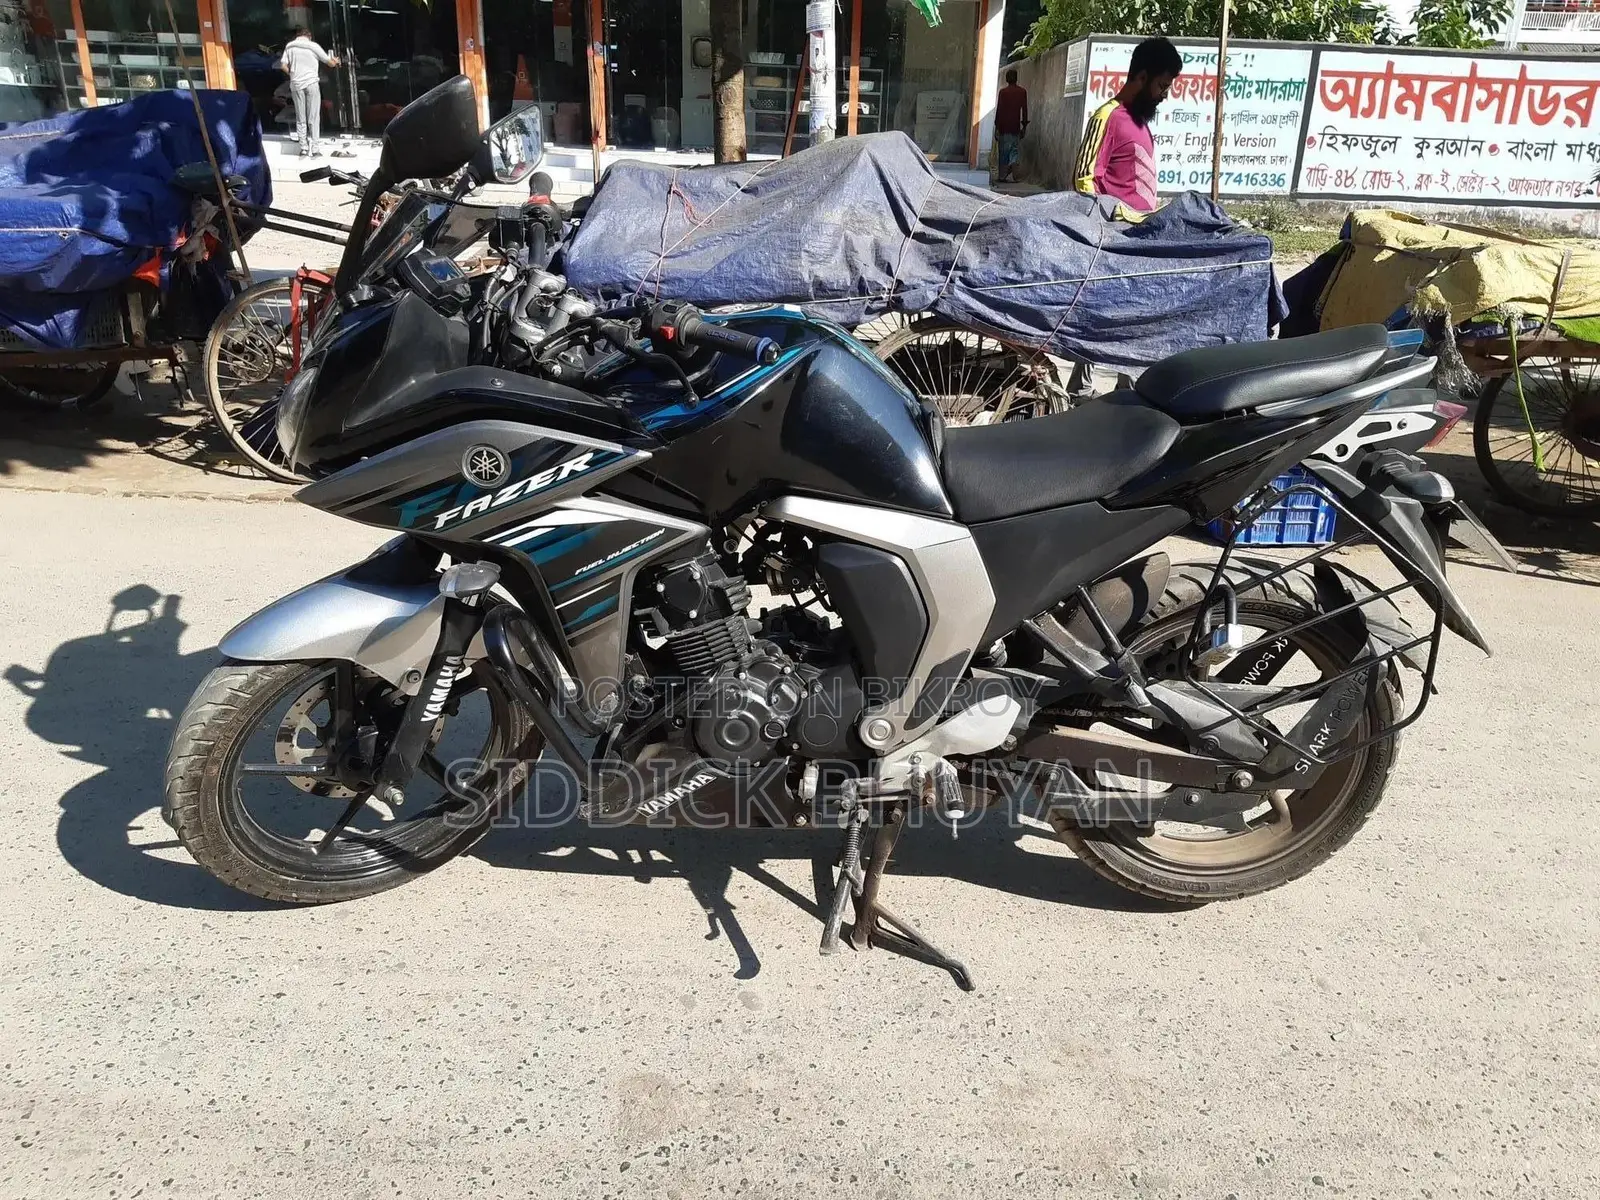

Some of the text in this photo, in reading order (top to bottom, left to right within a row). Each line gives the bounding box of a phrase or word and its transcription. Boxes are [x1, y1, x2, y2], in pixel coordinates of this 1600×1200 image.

[1168, 67, 1218, 105] জহার
[1254, 77, 1307, 103] মাদরাসা
[1319, 60, 1600, 129] অ্যামবাসাডর
[1171, 108, 1201, 129] হিফজ
[1184, 132, 1228, 151] Englih
[1233, 132, 1277, 148] Version
[1318, 125, 1600, 164] হিফজুল কুরআন বাংলা মাধ্য
[1157, 169, 1185, 186] 891,
[434, 452, 594, 530] FAZER
[574, 527, 667, 576] FUEL INJECTION
[420, 655, 464, 723] YAMAHA
[636, 771, 713, 816] YAMAHA
